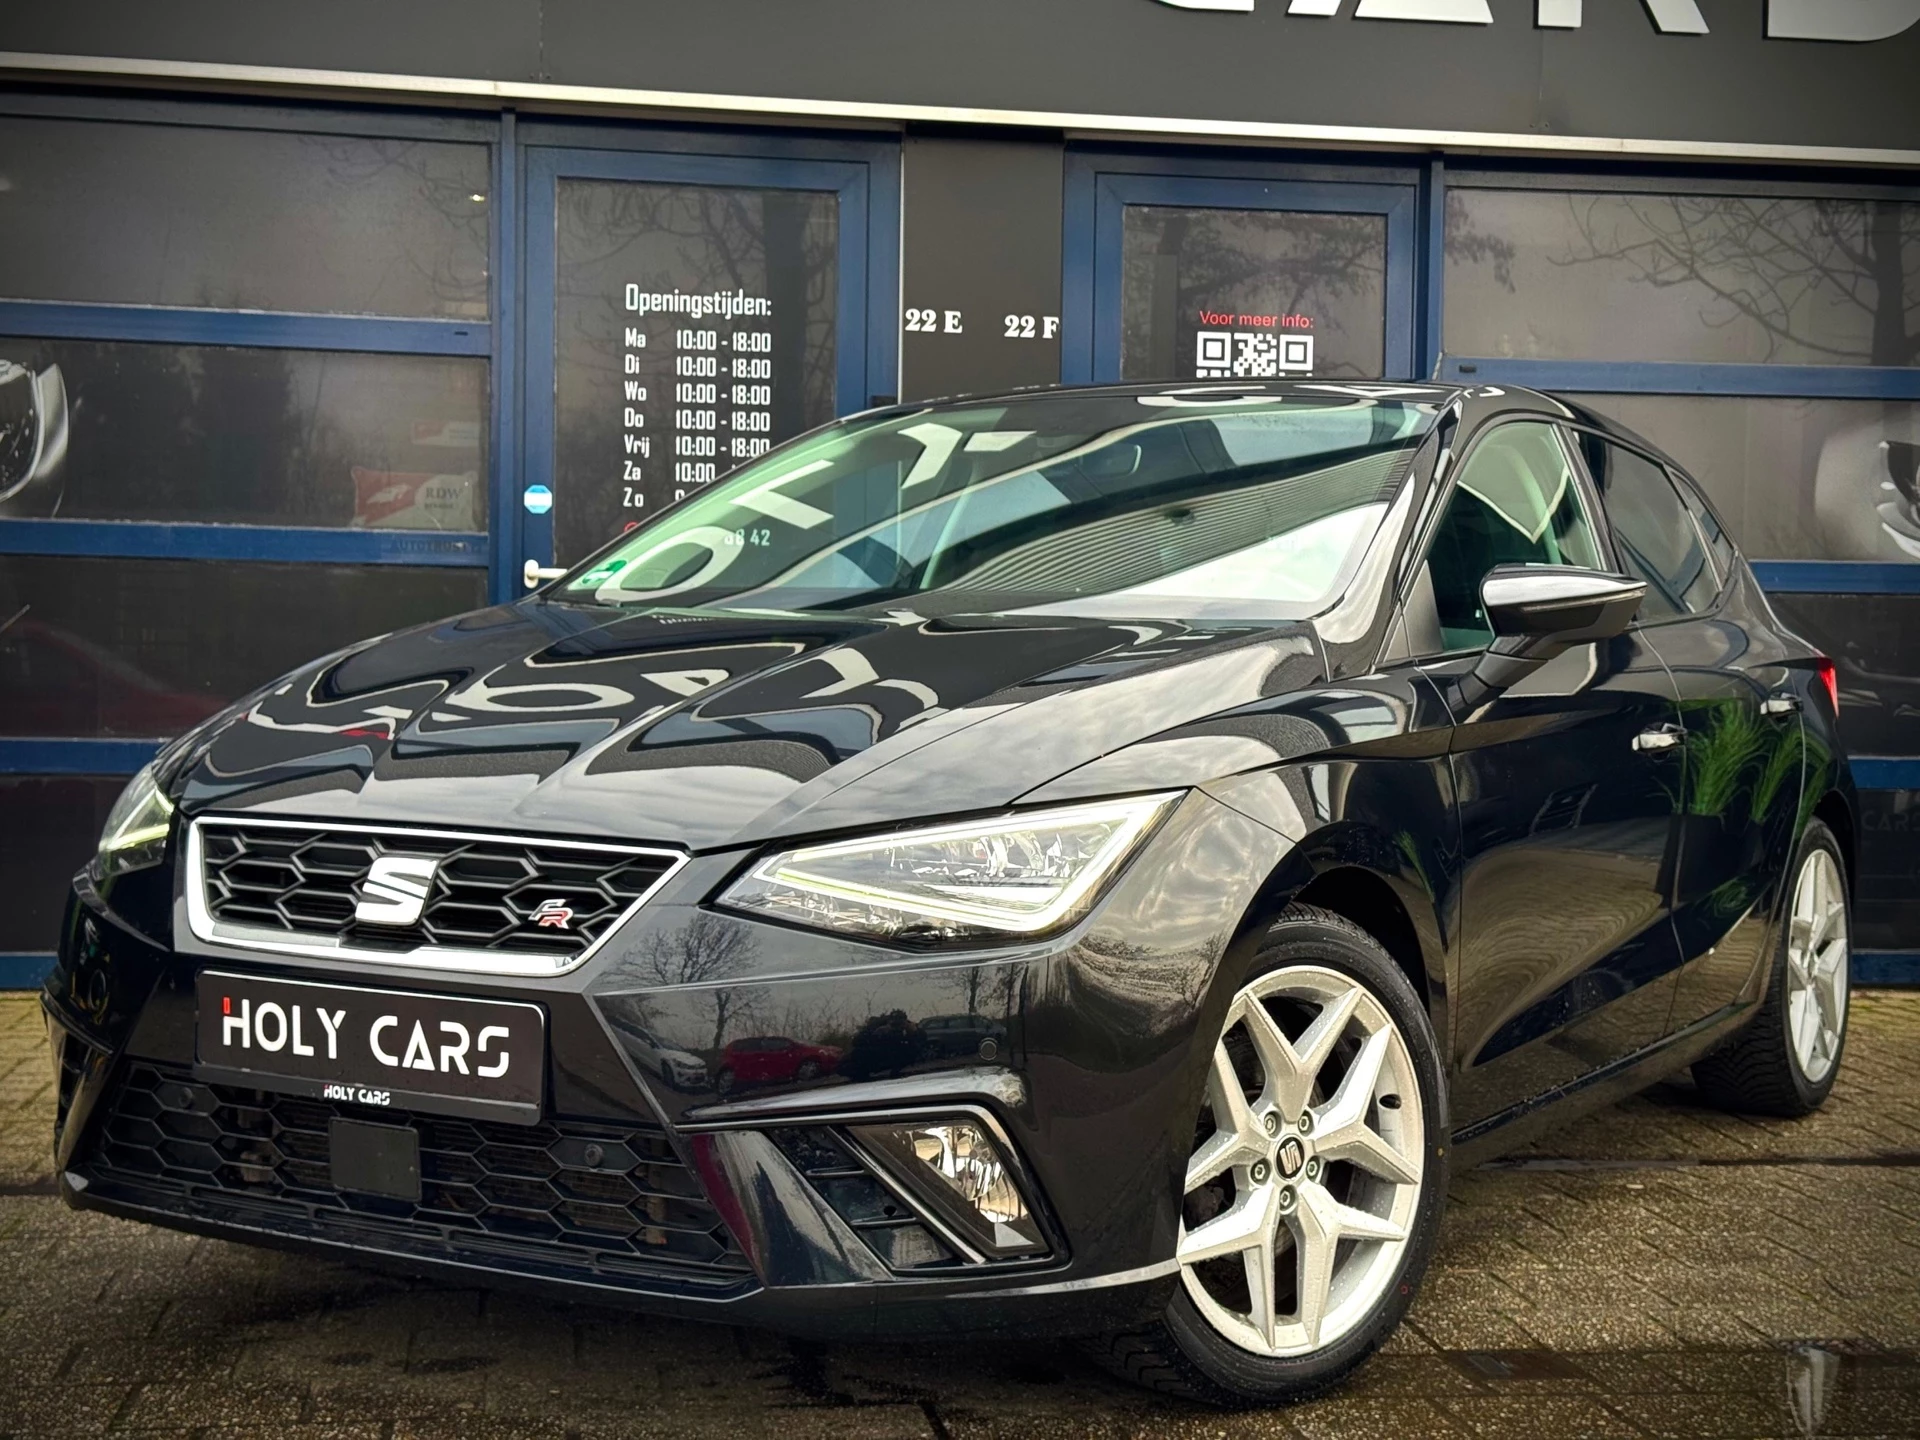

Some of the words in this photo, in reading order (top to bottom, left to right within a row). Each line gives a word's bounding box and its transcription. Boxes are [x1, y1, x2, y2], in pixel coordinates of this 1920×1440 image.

[625, 283, 772, 320] Openingstijden:
[904, 308, 937, 333] 22
[943, 310, 963, 334] E
[1003, 314, 1036, 338] 22
[1042, 316, 1060, 339] F
[1199, 310, 1235, 325] Voor
[1239, 315, 1278, 327] meer
[1282, 313, 1314, 329] info:
[625, 327, 646, 348] Ma
[676, 329, 716, 350] 10:00
[732, 332, 771, 353] 18:00
[624, 353, 640, 375] Di
[676, 356, 716, 377] 10:00
[732, 358, 771, 379] 18:00
[624, 380, 647, 401] Wo
[676, 383, 716, 403] 10:00
[732, 384, 771, 405] 18:00
[624, 407, 644, 428] Do
[676, 409, 716, 430] 10:00
[732, 411, 771, 432] 18:00
[624, 434, 650, 458] Vrij
[676, 436, 716, 456] 10:00
[623, 460, 641, 481] Za
[675, 462, 716, 483] 10:00
[750, 528, 770, 546] 42
[222, 996, 346, 1060] HOLY
[369, 1015, 510, 1078] CARS
[323, 1083, 355, 1101] HOLY
[358, 1088, 391, 1106] CARS
